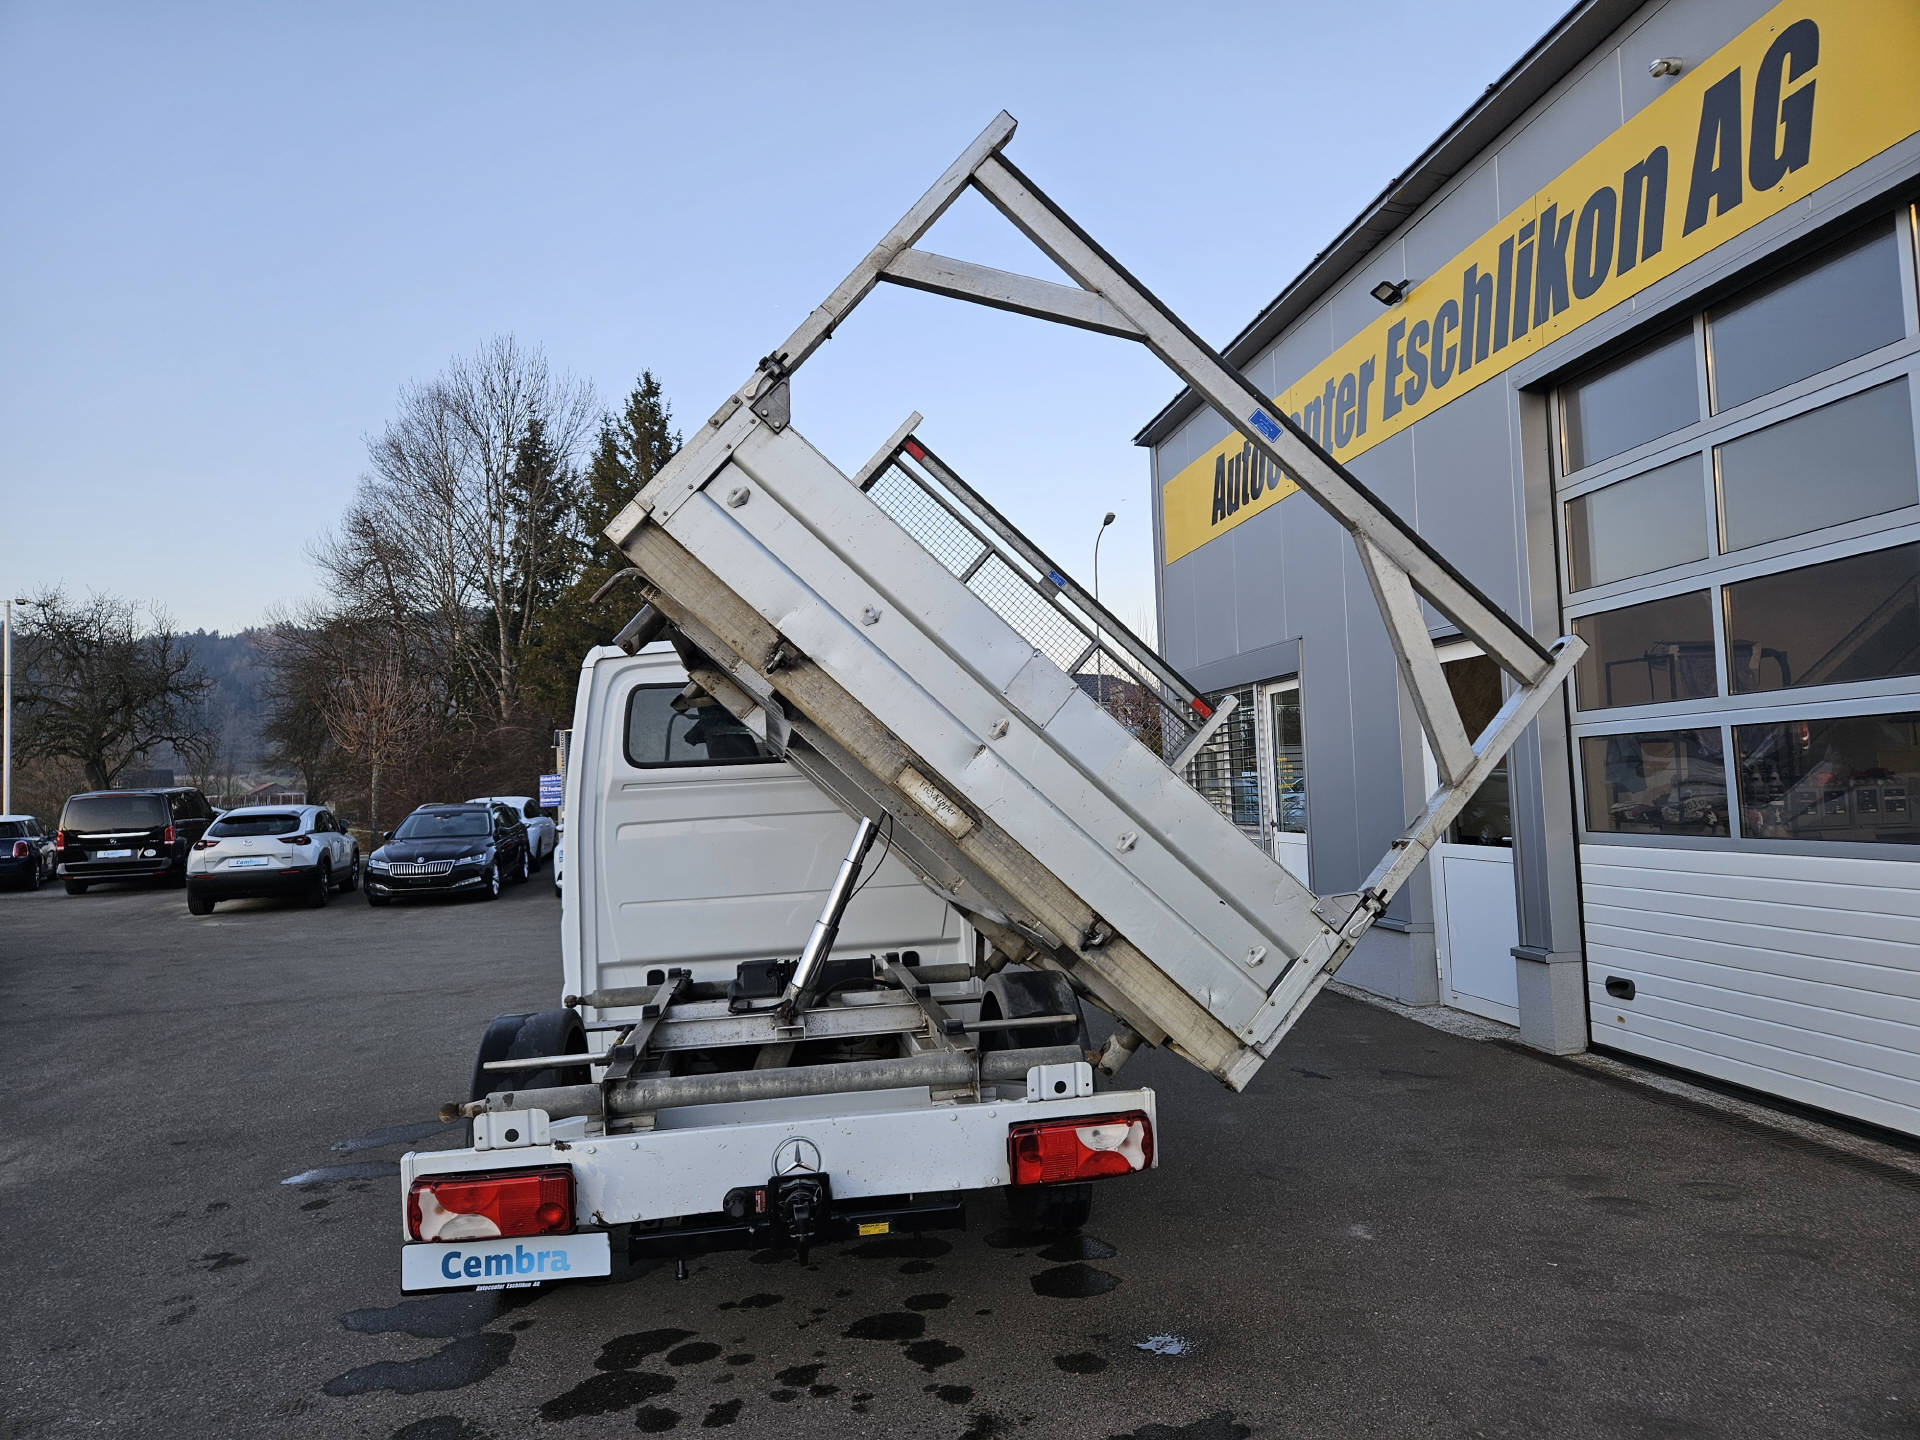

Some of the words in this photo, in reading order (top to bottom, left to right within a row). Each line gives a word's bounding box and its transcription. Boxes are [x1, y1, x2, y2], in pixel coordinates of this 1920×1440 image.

[1382, 145, 1669, 423] Eschlikon
[1682, 18, 1819, 238] AG
[441, 1244, 571, 1279] Cembra
